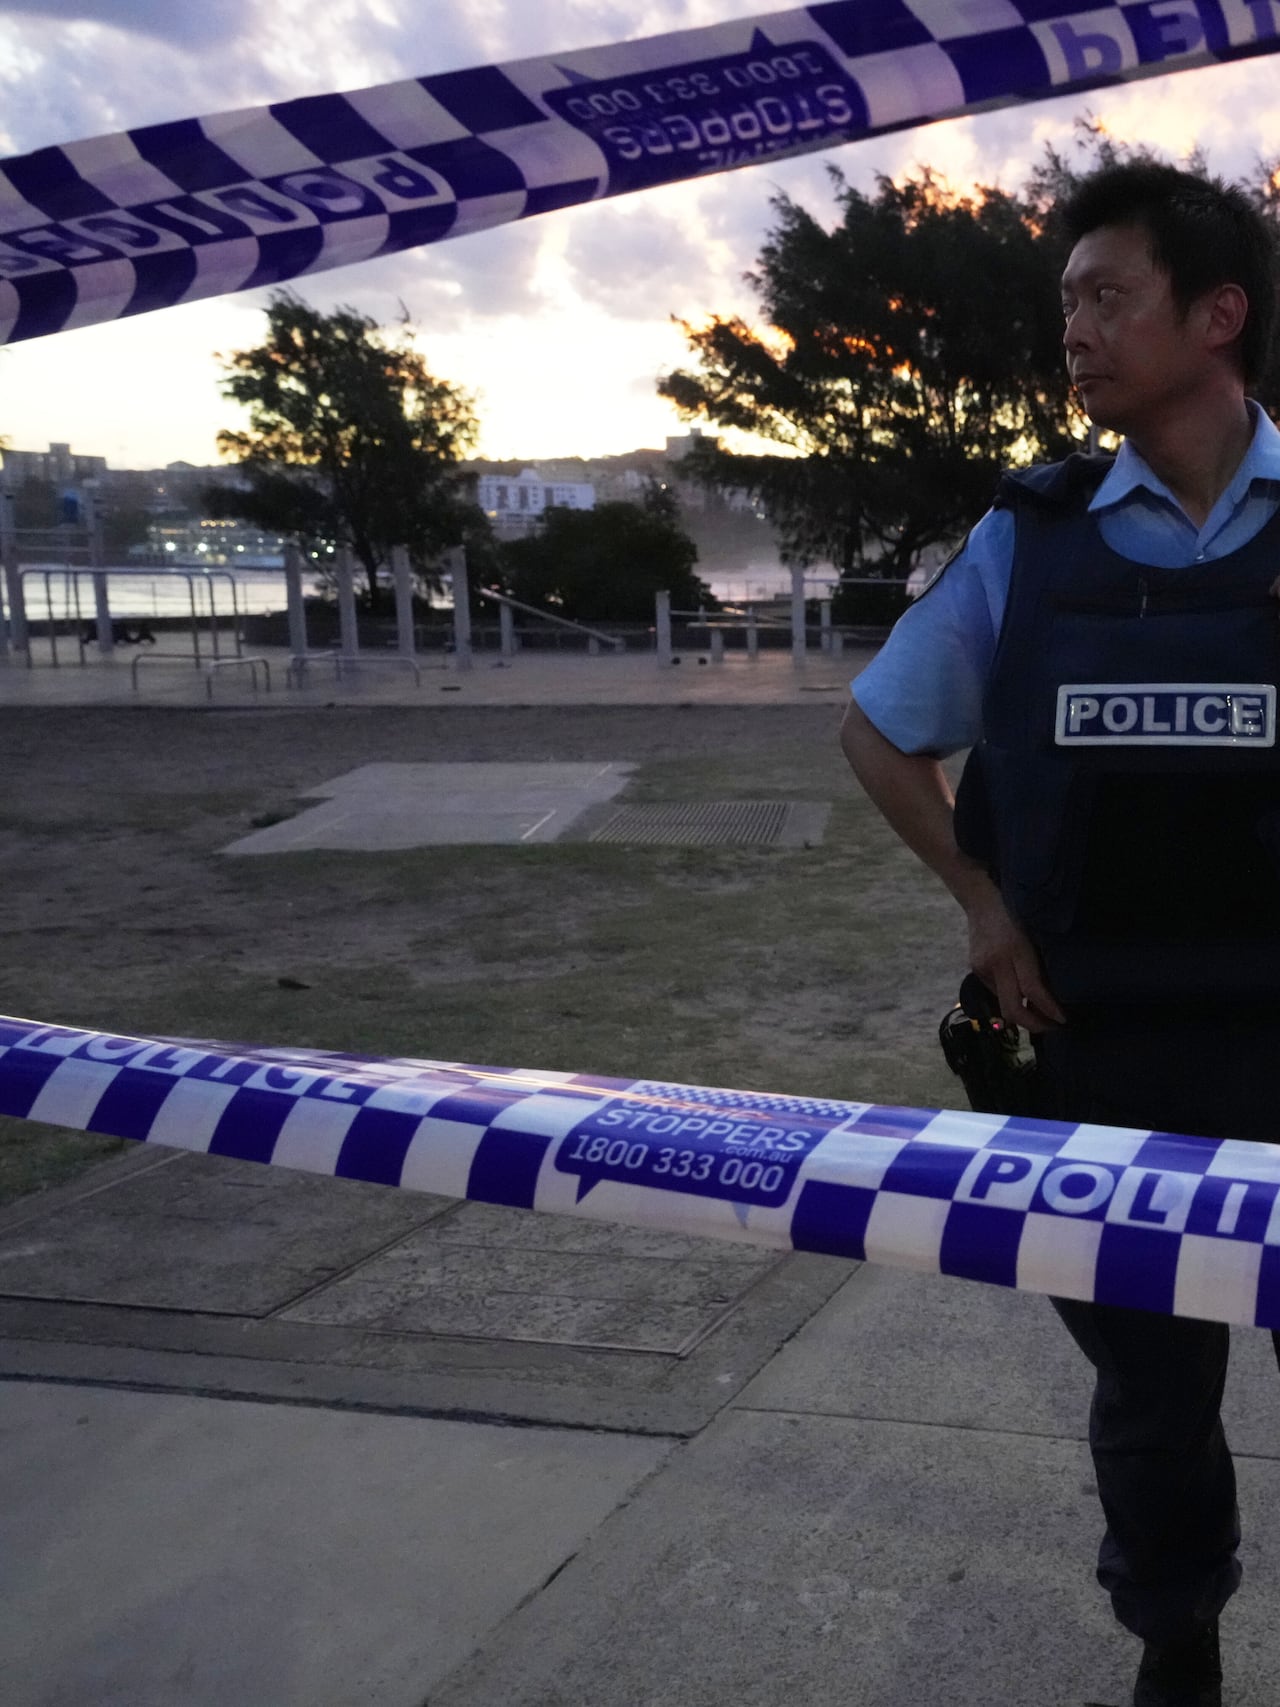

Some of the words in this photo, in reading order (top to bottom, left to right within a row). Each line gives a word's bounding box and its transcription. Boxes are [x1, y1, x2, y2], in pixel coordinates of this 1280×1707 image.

[565, 89, 643, 120] 000
[603, 84, 852, 160] STOPPERS
[18, 157, 440, 260] POLICE
[1068, 695, 1263, 734] POLICE
[596, 1108, 812, 1152] STOPPERS
[569, 1134, 649, 1170] 1800
[652, 1147, 715, 1180] 333
[718, 1158, 785, 1193] 000
[719, 1143, 793, 1164] .com.au
